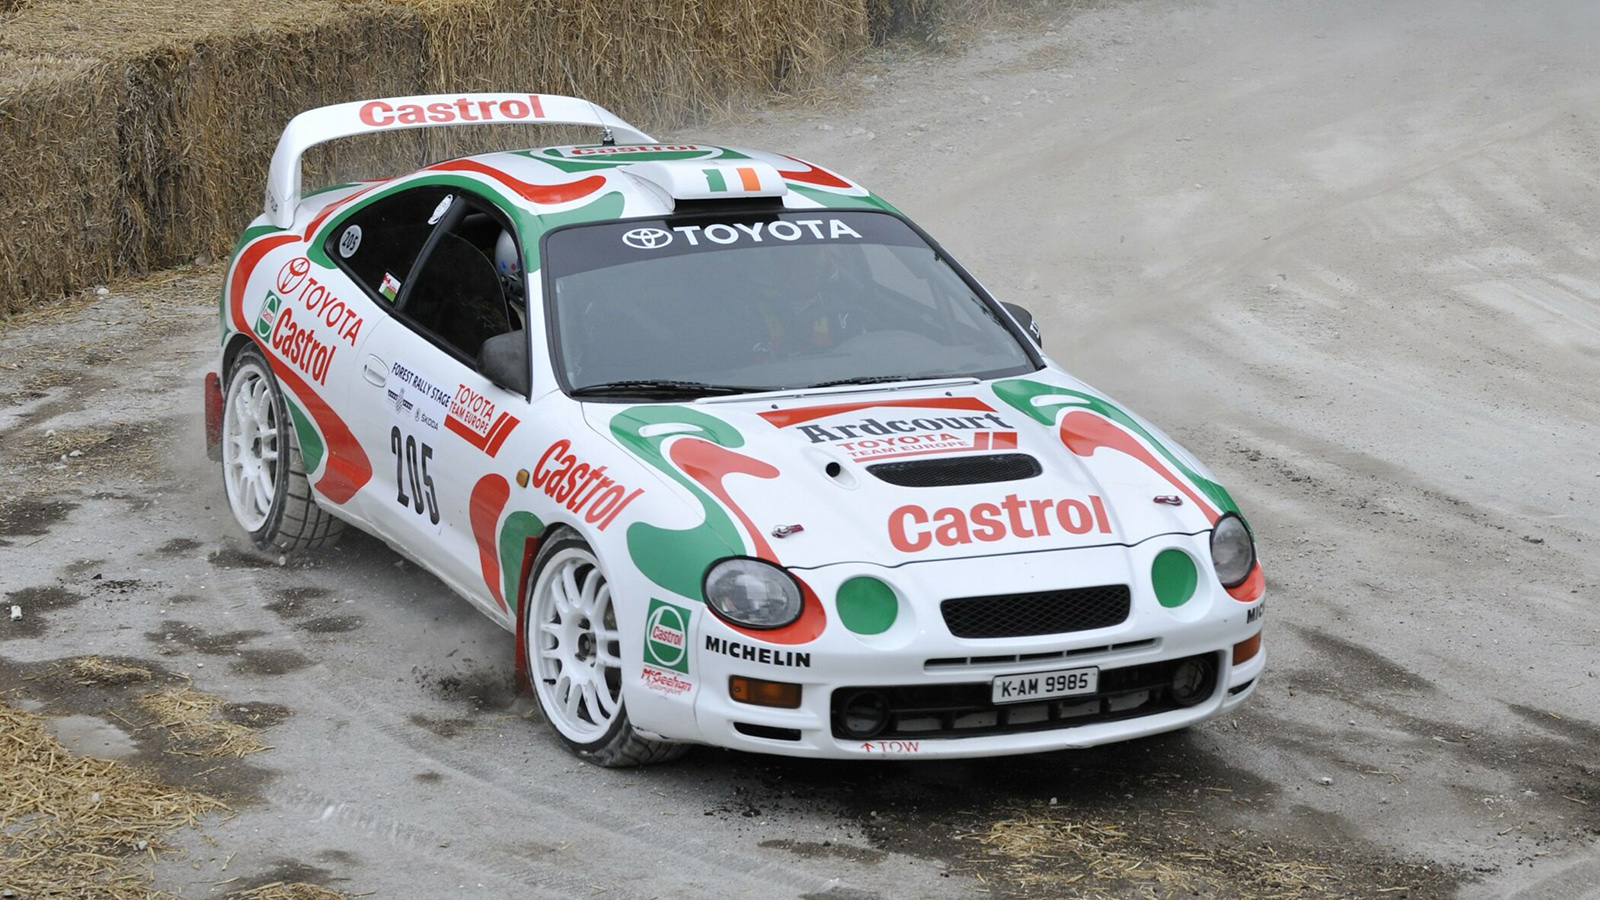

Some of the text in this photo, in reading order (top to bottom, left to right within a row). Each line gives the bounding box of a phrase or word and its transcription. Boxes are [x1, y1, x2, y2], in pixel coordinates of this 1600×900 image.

[359, 95, 545, 127] Castrol
[572, 144, 698, 155] Castrol
[342, 231, 359, 251] 205
[672, 219, 863, 246] TOYOTA
[298, 277, 363, 347] TOYOTA
[272, 307, 337, 386] Castrol
[391, 362, 414, 384] FOREST
[412, 375, 433, 395] RALLY
[430, 387, 451, 408] STAGE
[449, 401, 489, 434] TEAM EUROPE
[455, 383, 495, 421] TOYOTA
[796, 413, 1015, 443] Ardcourt
[836, 433, 961, 450] TOYOTA
[847, 440, 970, 458] TEAM EUROPE
[391, 425, 440, 525] 205
[532, 439, 645, 531] Castrol
[887, 494, 1113, 553] Castrol
[652, 625, 683, 647] Castrol
[705, 635, 811, 668] MICHELIN
[1001, 673, 1089, 698] K-AM 9985
[877, 741, 920, 753] TOW
